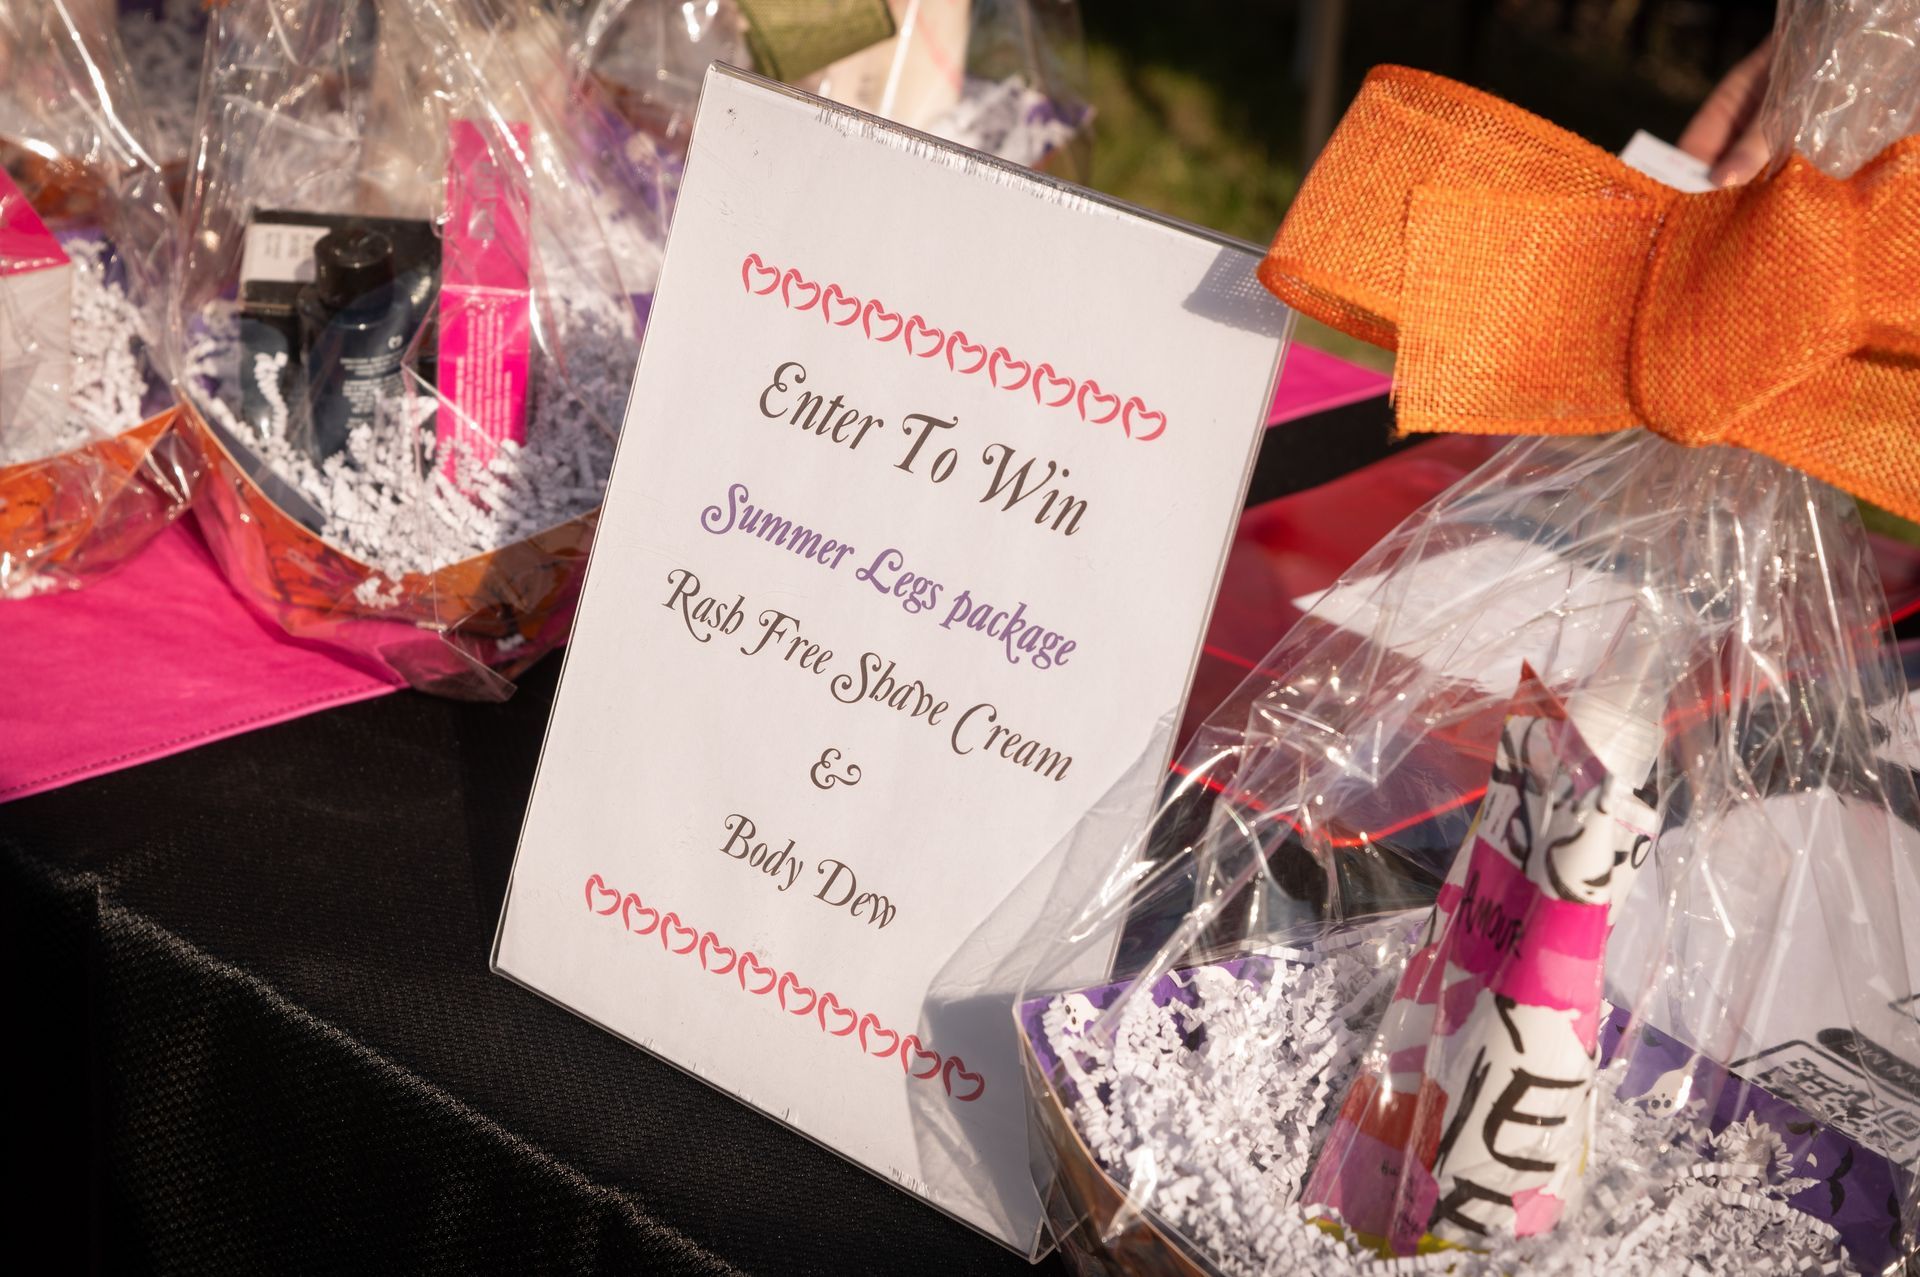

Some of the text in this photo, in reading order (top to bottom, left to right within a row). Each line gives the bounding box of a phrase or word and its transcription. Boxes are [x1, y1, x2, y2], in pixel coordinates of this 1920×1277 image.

[758, 361, 1088, 537] Enter To Win
[700, 483, 1077, 670] Summer Legs package
[661, 568, 1073, 782] Rash Free Shave Cream
[809, 747, 862, 791] &
[719, 813, 898, 930] Body Dew
